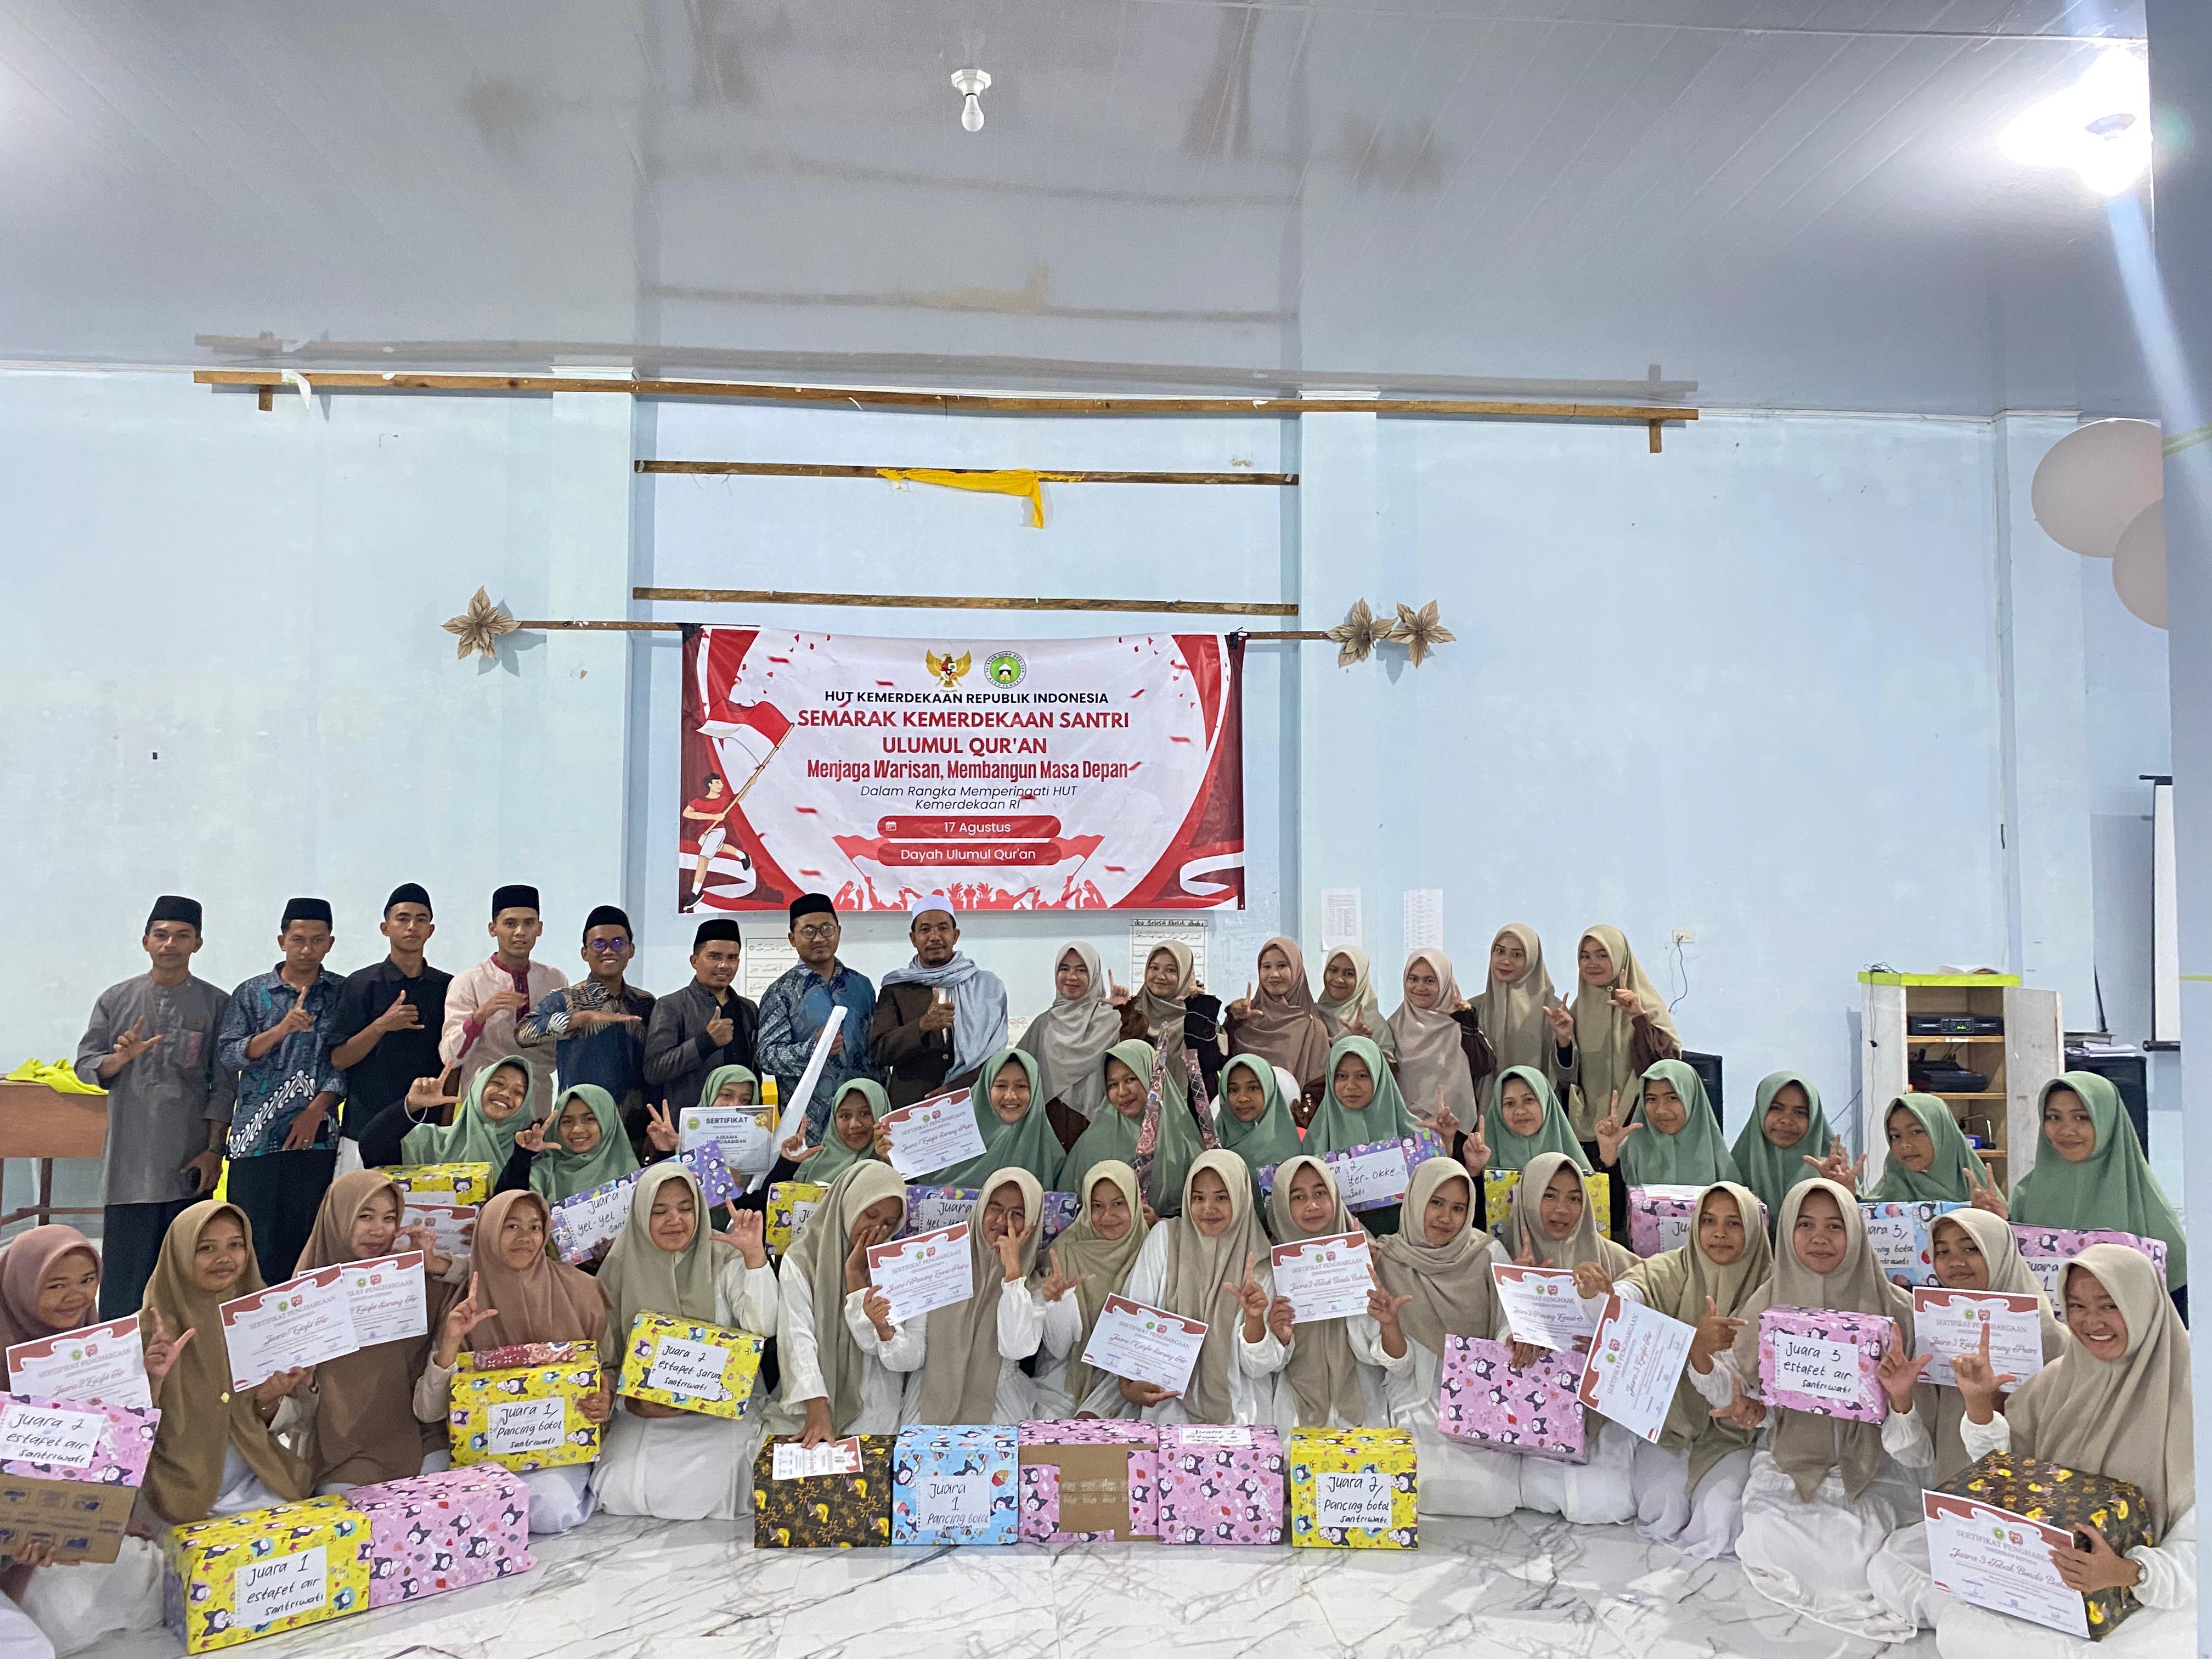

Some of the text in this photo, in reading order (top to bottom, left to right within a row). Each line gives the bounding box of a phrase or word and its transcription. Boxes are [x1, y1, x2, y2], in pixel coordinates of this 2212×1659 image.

[825, 691, 1109, 703] HUT KEMERDEKAAN REPUBLIK INDONESIA
[797, 710, 1129, 728] SEMARAK KEMERDEKAAN SANTRI
[883, 737, 1047, 757] ULUMUL QUR'AN
[808, 759, 1128, 782] Menjaga Warisan, Membangun Masa Depan
[861, 786, 1077, 799] Dalam Rangka Memperingati HUT
[916, 799, 1020, 809] Kemerdekaan RI
[944, 822, 1011, 836] 17 Agustus
[901, 849, 1036, 862] Dayah Ulumul Qur'an
[587, 1192, 619, 1214] Juara
[937, 1202, 972, 1215] Juara
[1291, 1259, 1363, 1273] SERTIFIKAT PENGHARGAAN
[250, 1313, 286, 1329] SERTIFIKAT
[287, 1295, 337, 1316] PENGHARGAAN
[1119, 1321, 1191, 1350] SERTIFIKAT PENGHARGAAN
[662, 1345, 706, 1362] Juara 2
[1786, 1342, 1820, 1358] Juara
[658, 1360, 694, 1374] estapet
[1784, 1361, 1853, 1380] estafet air
[664, 1377, 707, 1390] santriwati
[1802, 1379, 1852, 1393] santriwati
[9, 1414, 85, 1430] Juara 2
[500, 1406, 538, 1425] Juara
[539, 1420, 562, 1431] botol
[65, 1441, 89, 1450] air
[510, 1437, 555, 1448] santriwati
[19, 1449, 85, 1463] santriwati
[928, 1483, 966, 1499] Juara
[1327, 1476, 1363, 1492] Juara
[951, 1496, 959, 1510] 1
[1956, 1530, 2002, 1547] SERTIFIKAT
[1949, 1548, 1979, 1562] Juara
[246, 1554, 308, 1587] Juara 1
[247, 1578, 320, 1604] estafet air
[265, 1594, 323, 1616] santriwati
